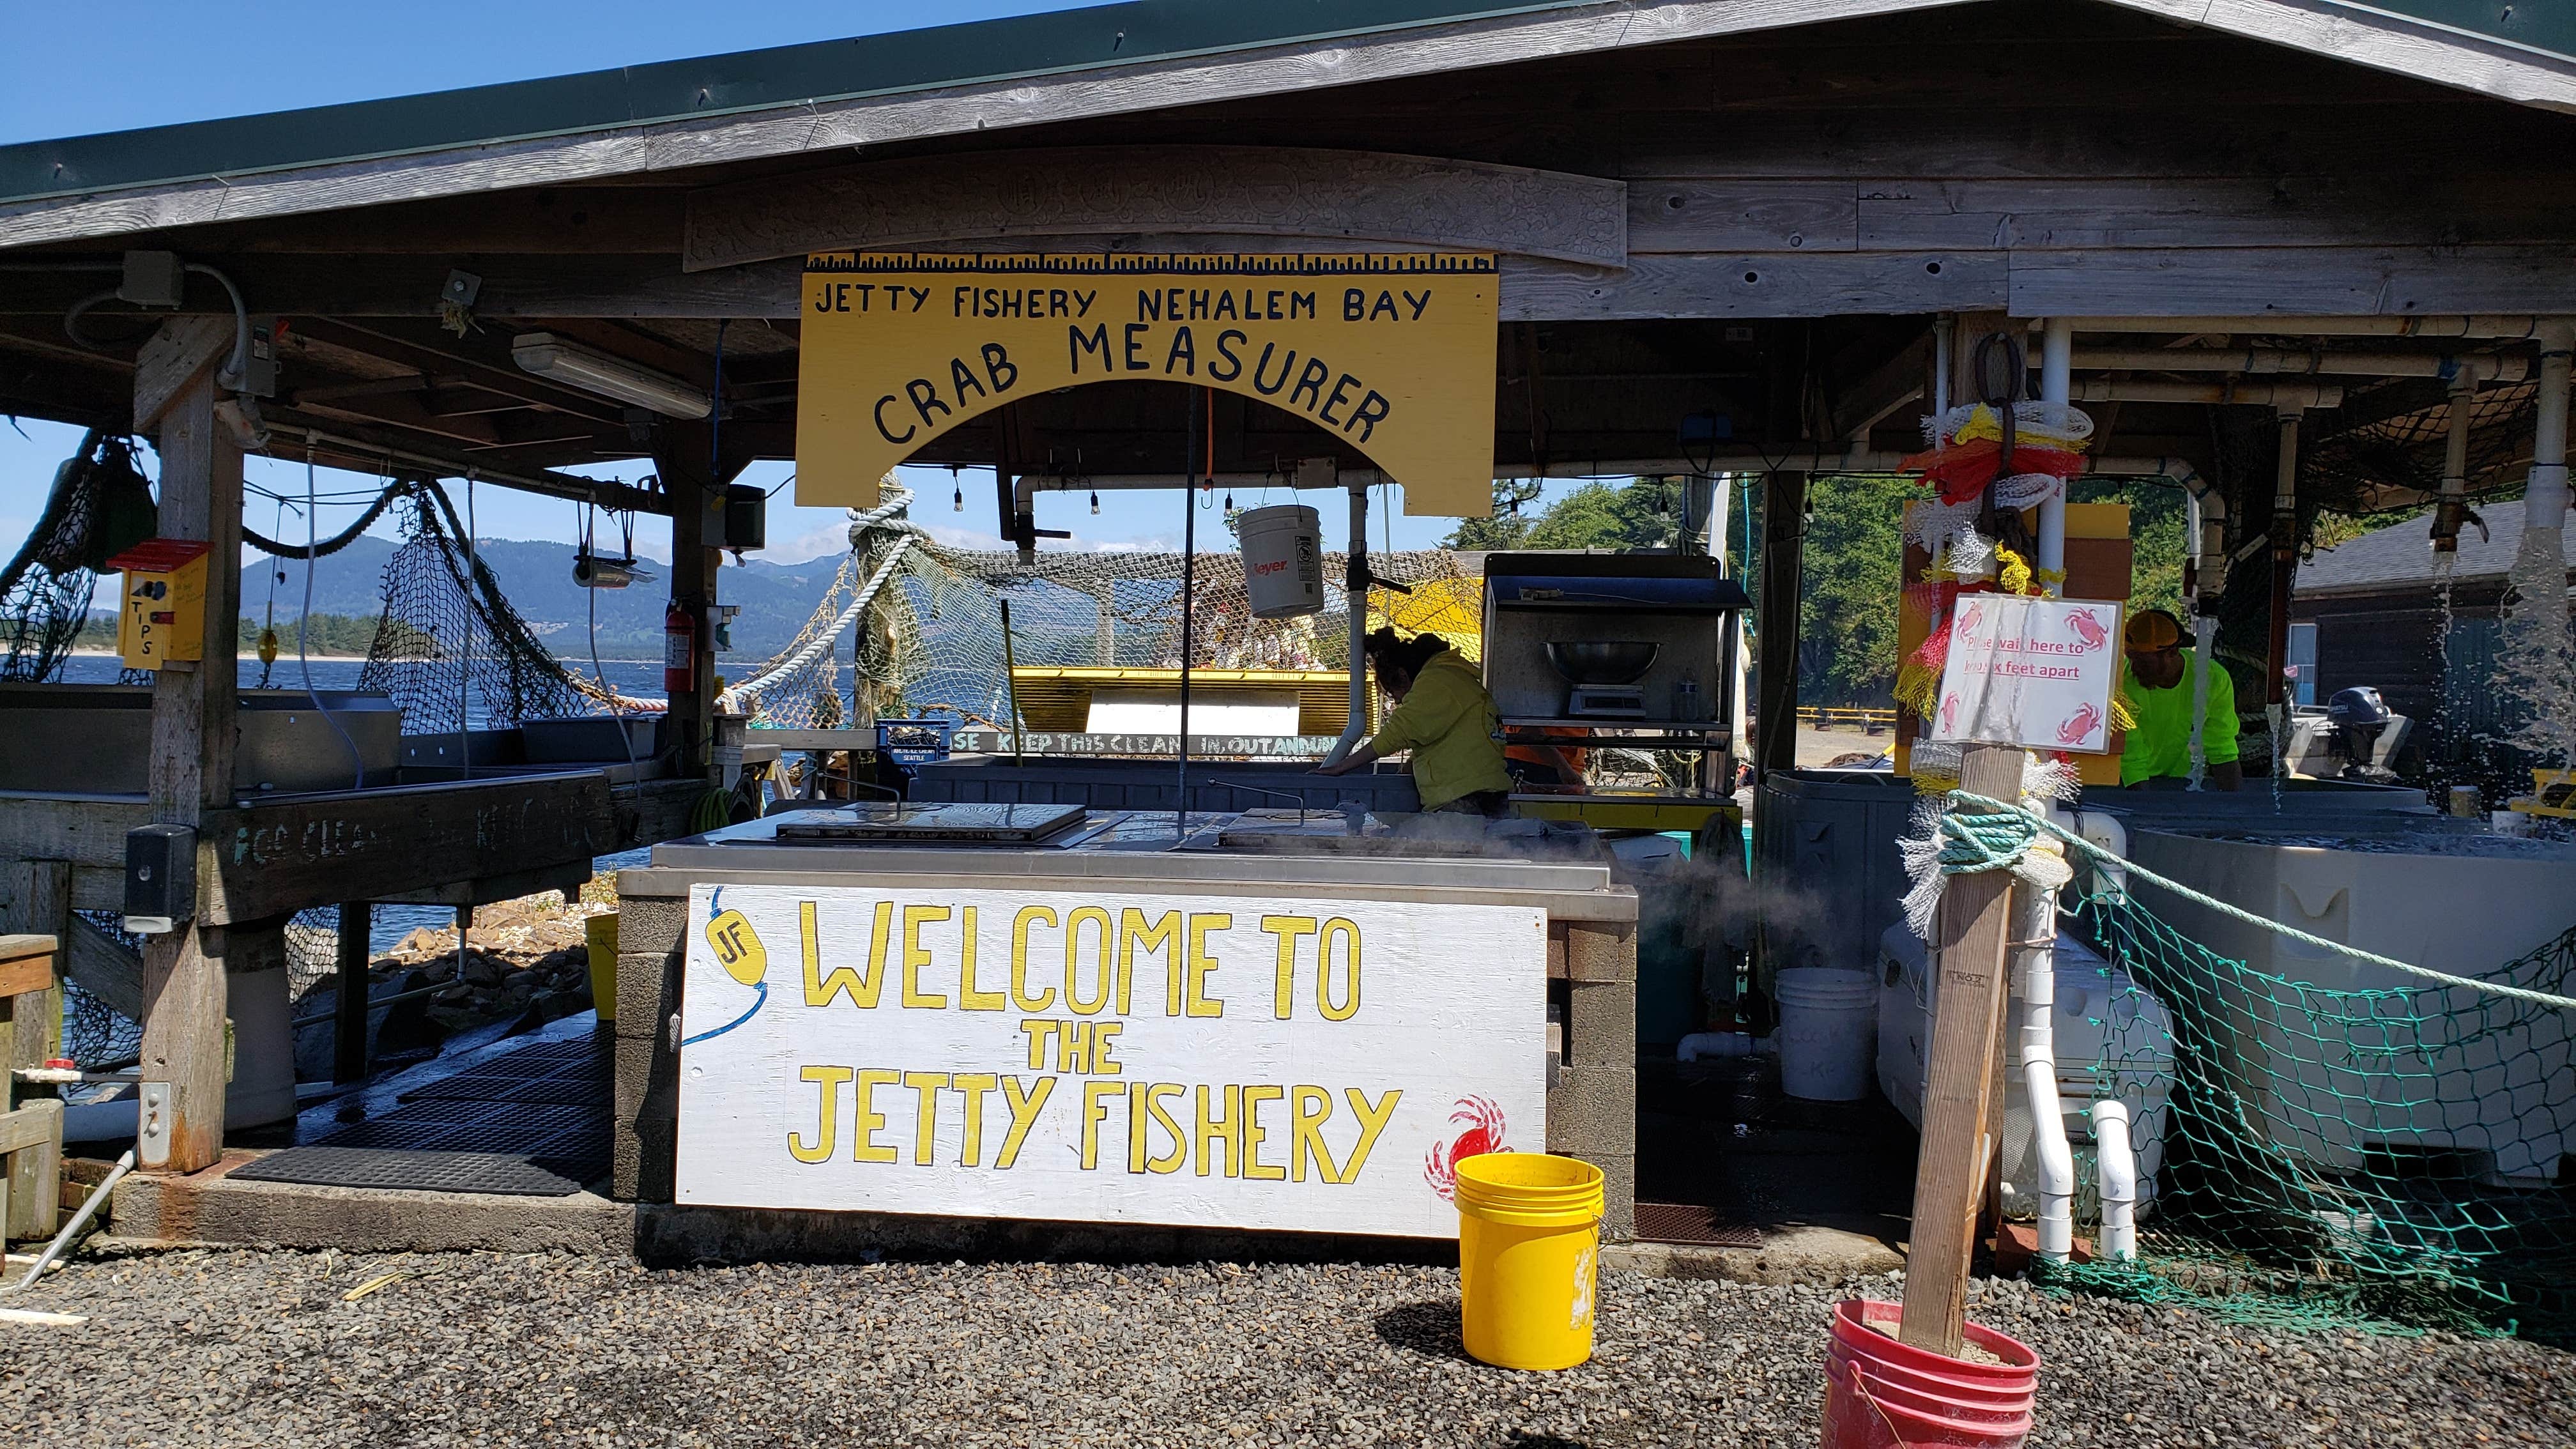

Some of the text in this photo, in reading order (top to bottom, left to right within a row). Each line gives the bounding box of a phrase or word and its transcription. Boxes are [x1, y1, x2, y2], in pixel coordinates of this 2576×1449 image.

[815, 283, 1432, 323] JETTY FISHERY NEHALEM BAY
[873, 322, 1392, 445] CRAB MEASURER
[131, 601, 153, 656] TIPS
[2030, 638, 2064, 652] here
[2068, 643, 2084, 654] to
[2006, 661, 2035, 675] feet
[2039, 666, 2080, 679] apart
[1057, 733, 1105, 753] THIS
[1110, 734, 1181, 753] CLEAN
[716, 920, 748, 964] JF
[799, 900, 1363, 1022] WELCOME TO
[1020, 1018, 1123, 1076] THE
[788, 1064, 1404, 1186] JETTY FISHERY
